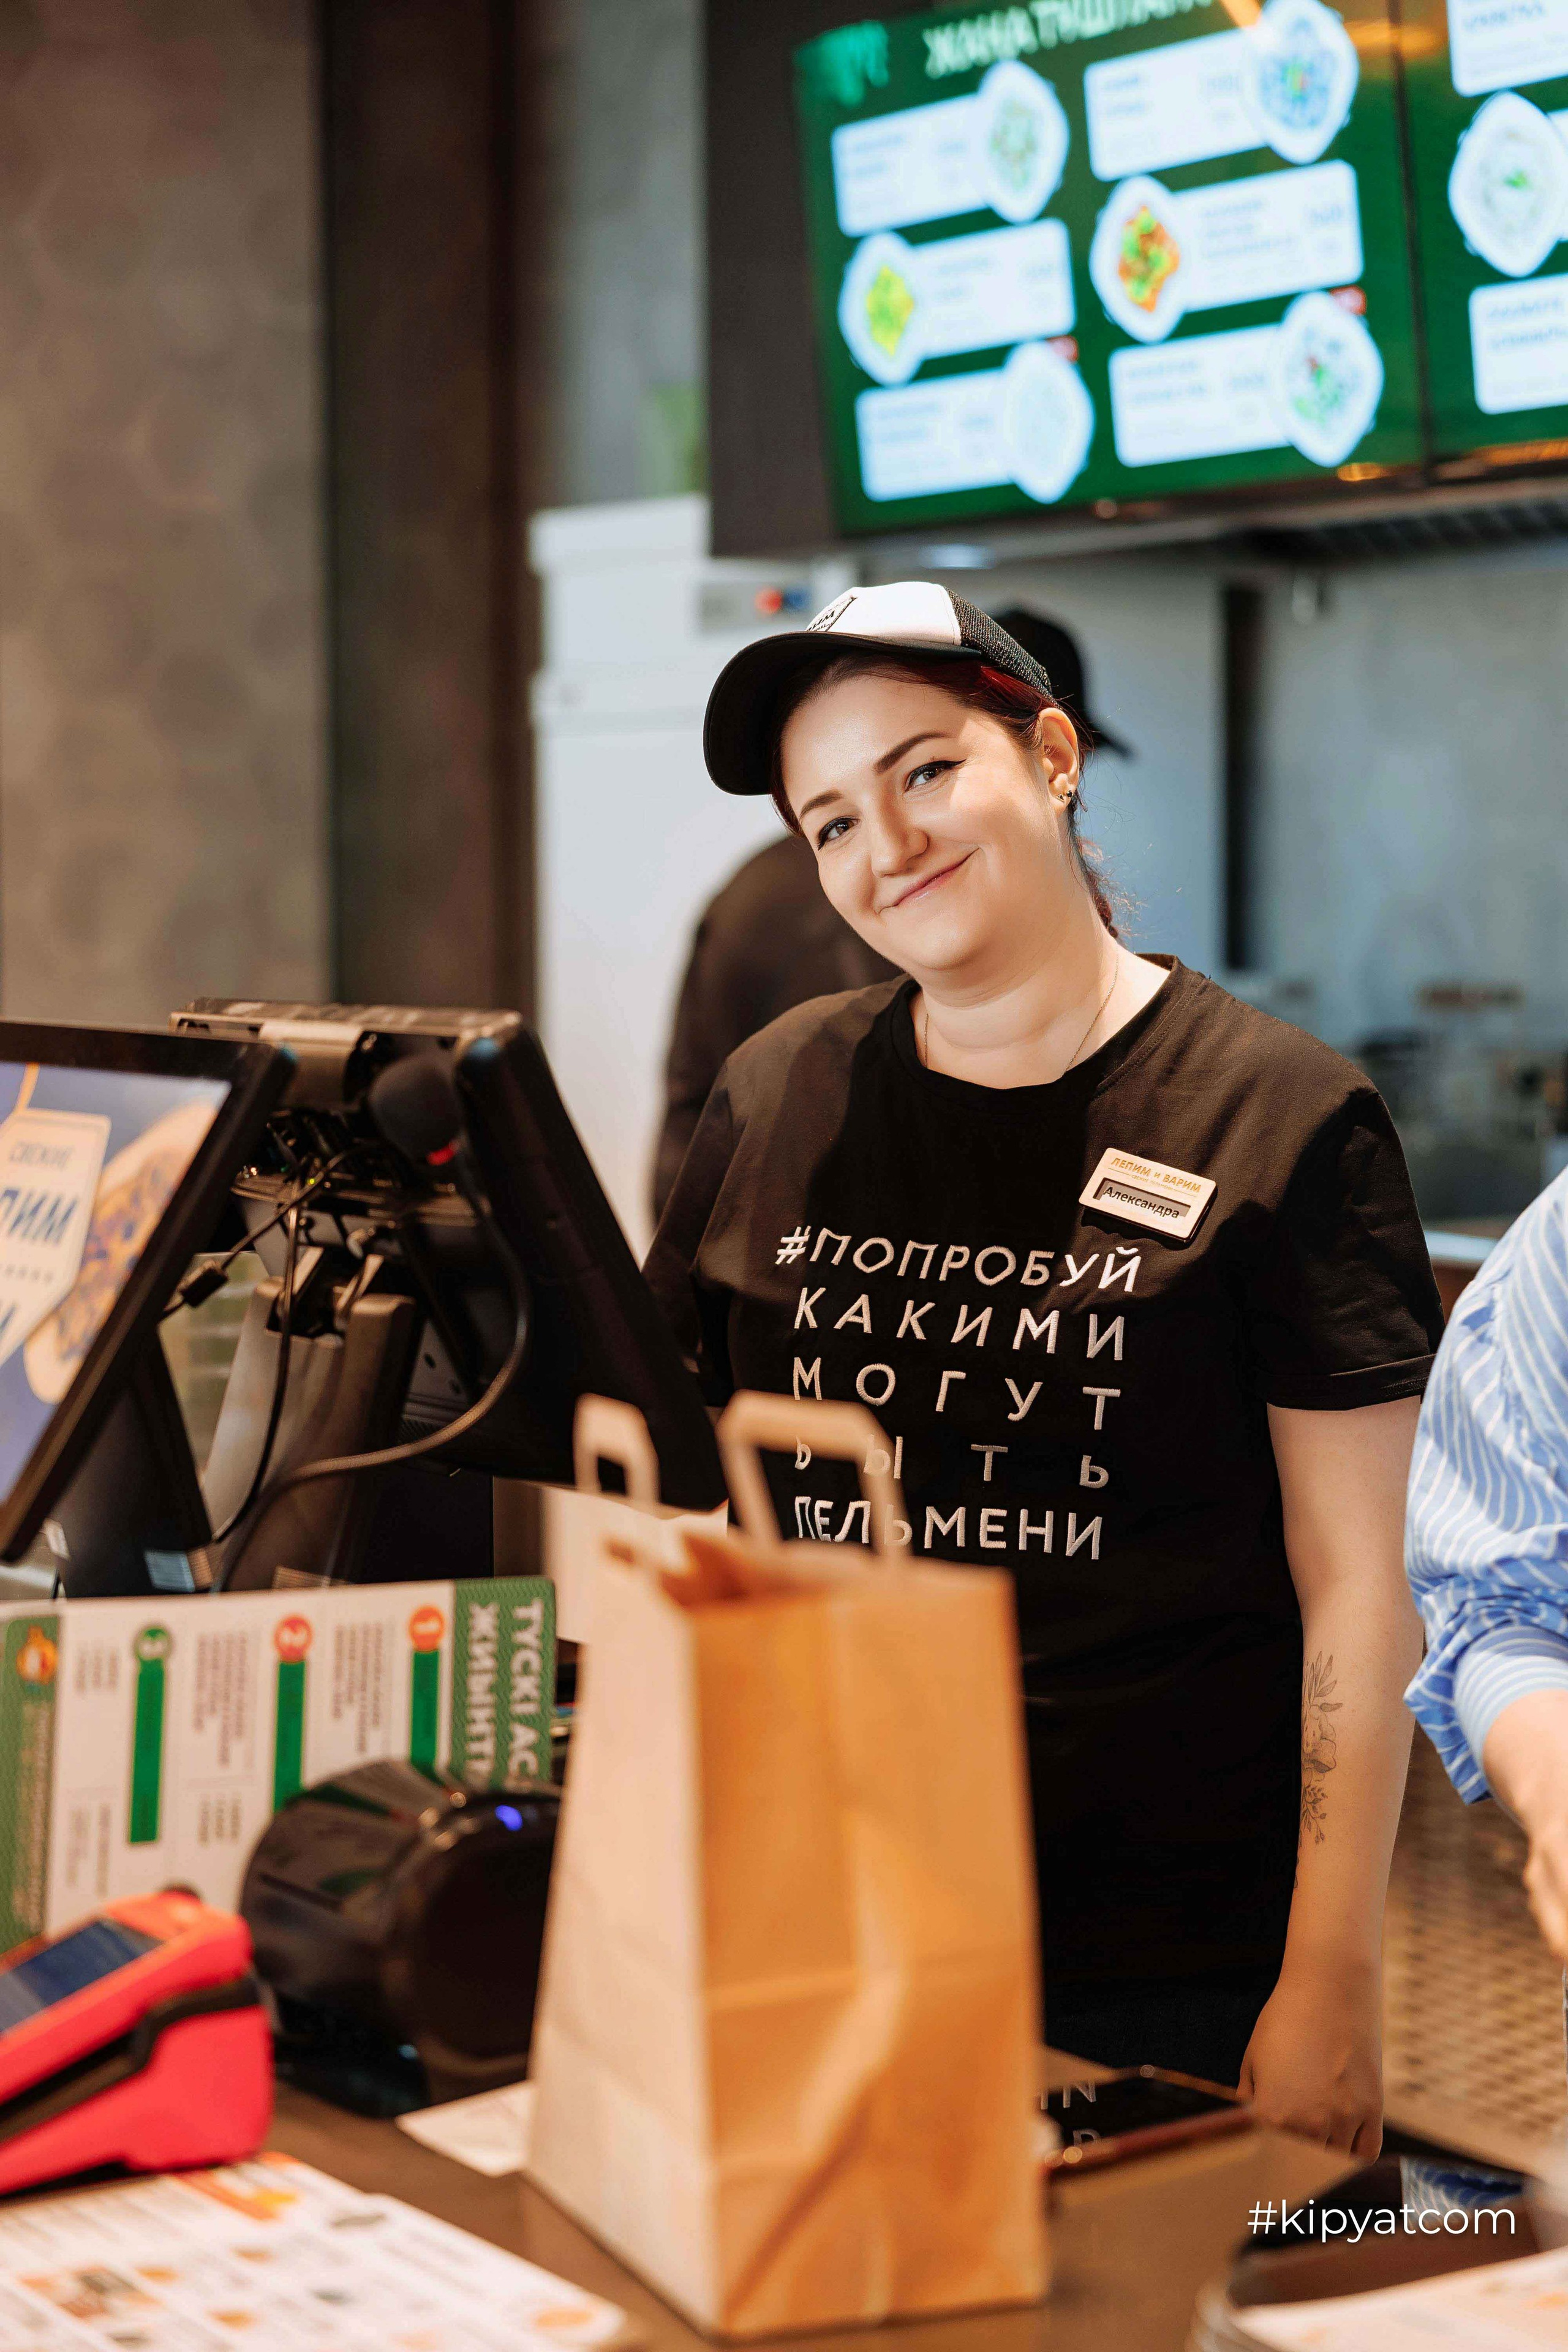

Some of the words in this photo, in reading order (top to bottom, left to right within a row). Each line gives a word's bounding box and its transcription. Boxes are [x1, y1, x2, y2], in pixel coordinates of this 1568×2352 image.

[1102, 1186, 1180, 1219] Александра
[1111, 1157, 1152, 1177] ЛЕПИМ
[1163, 1174, 1202, 1193] ВАРИМ
[775, 1226, 1142, 1292] #ПОПРОБУЙ
[794, 1287, 1125, 1362] КАКИМИ
[794, 1357, 1121, 1430] МОГУТ
[794, 1496, 1104, 1561] ПЕЛЬМЕНИ
